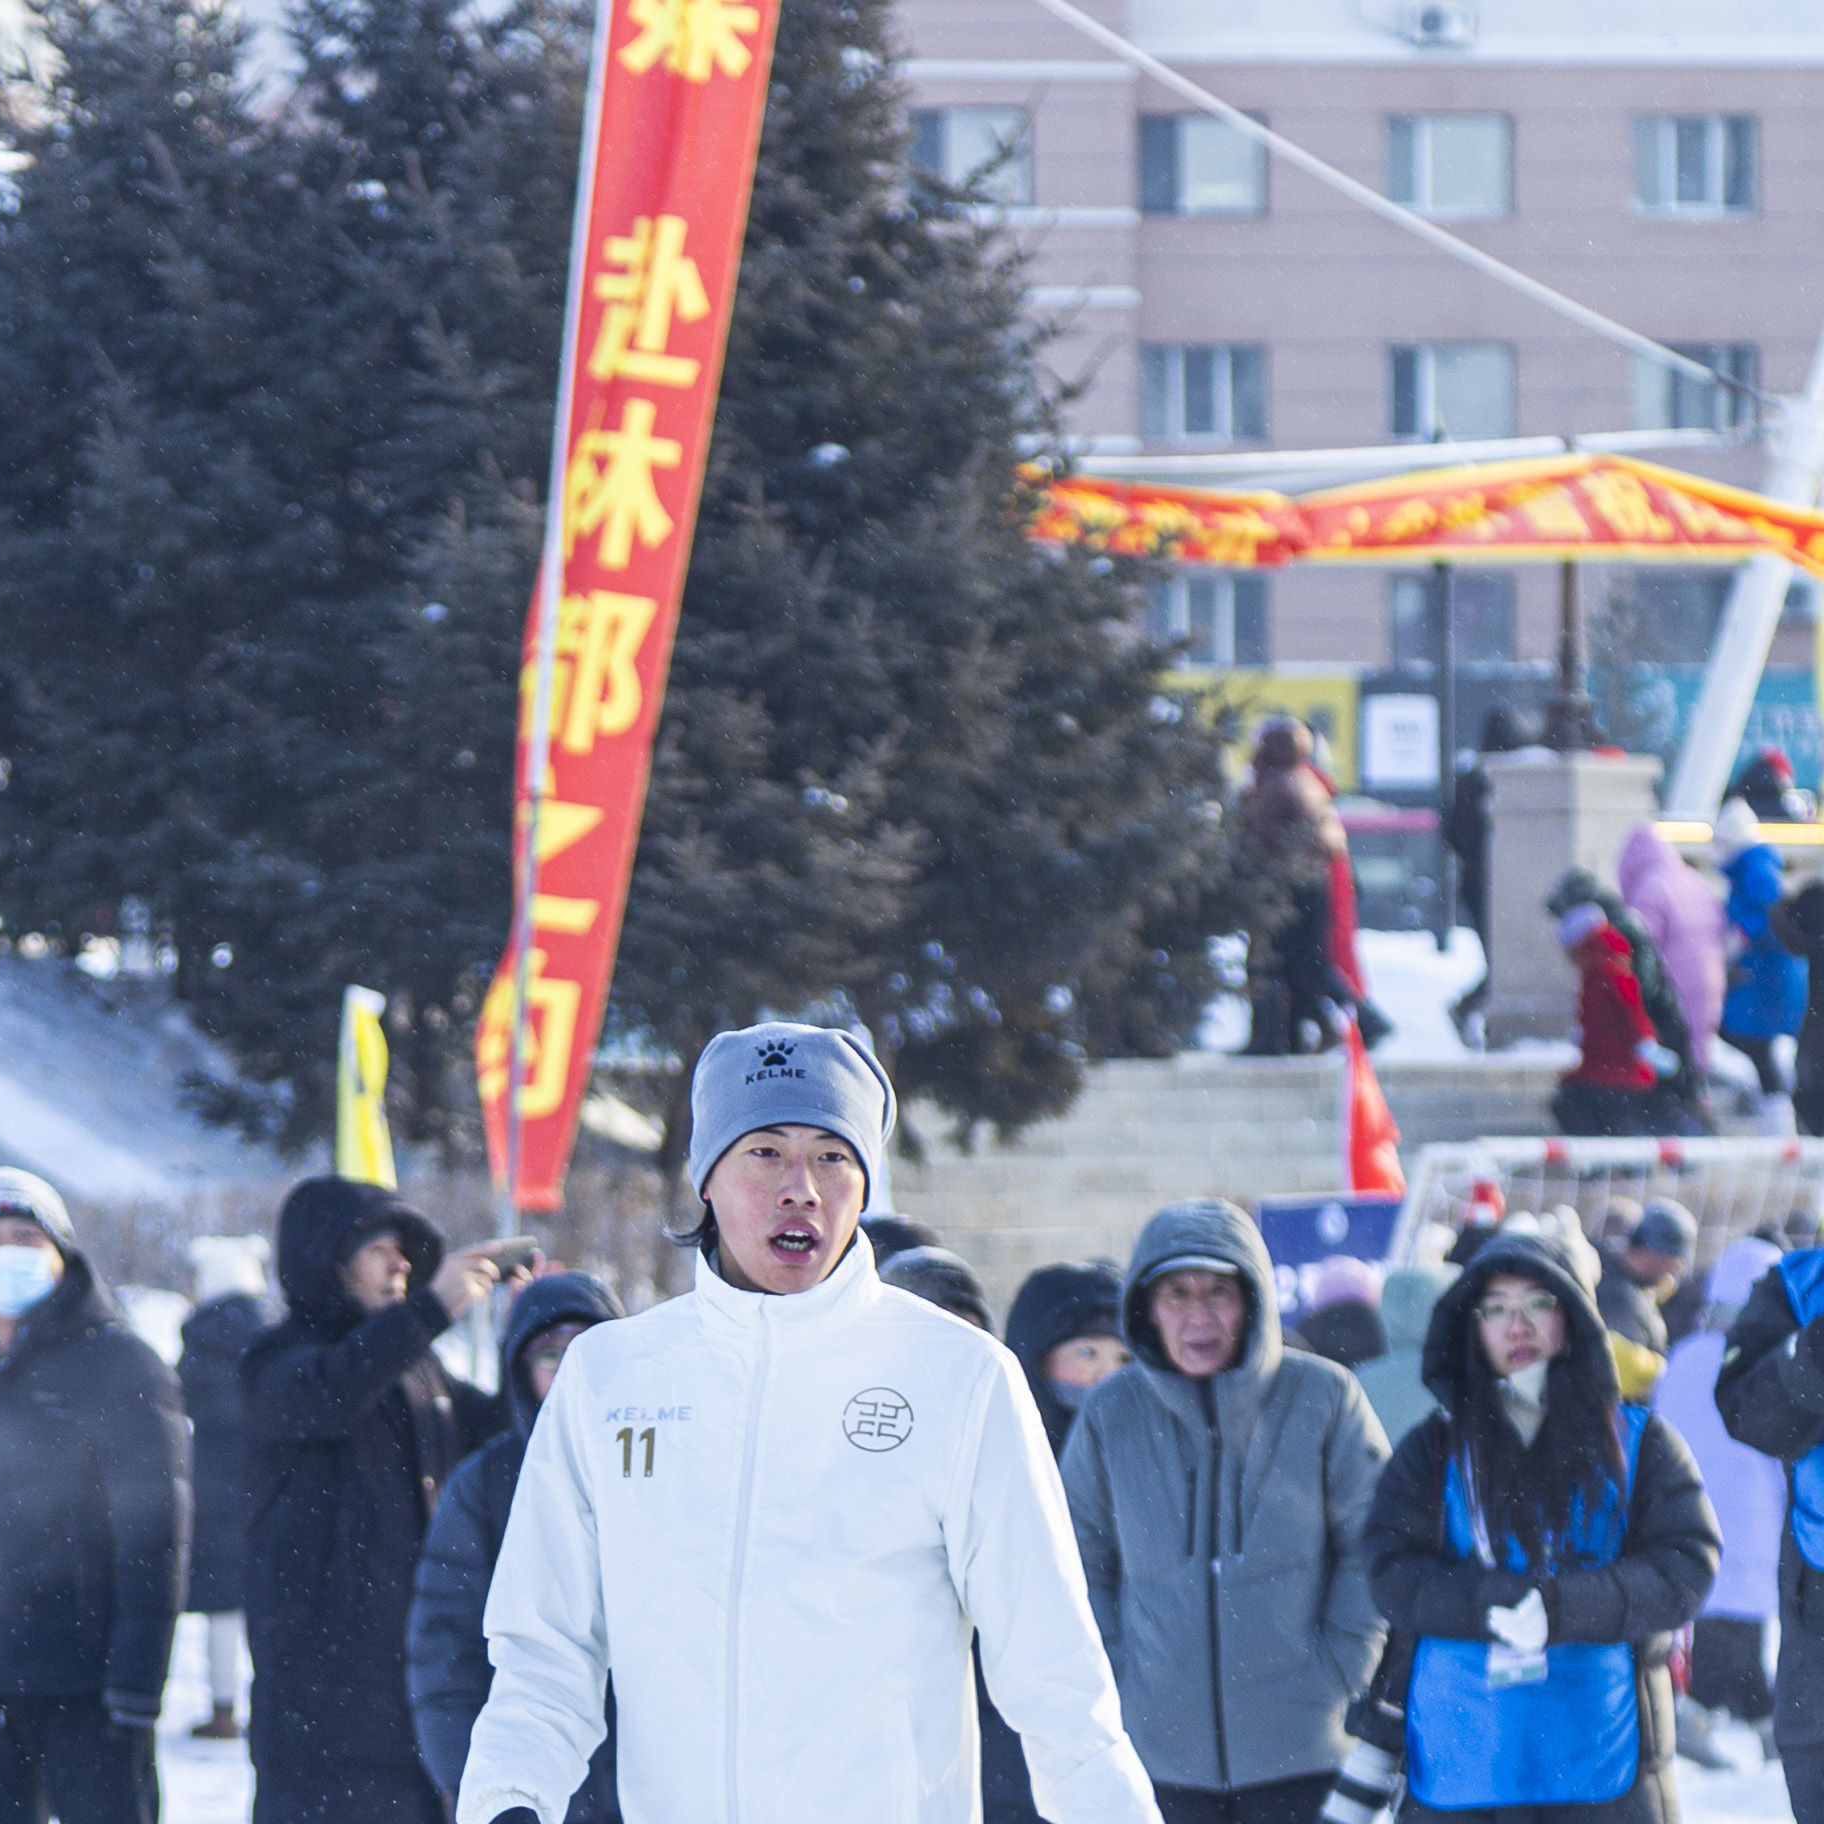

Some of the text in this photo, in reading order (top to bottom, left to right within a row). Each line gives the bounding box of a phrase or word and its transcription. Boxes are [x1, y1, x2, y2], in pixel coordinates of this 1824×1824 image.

[745, 1067, 807, 1086] KELME
[605, 1405, 694, 1423] KELME
[615, 1427, 656, 1478] 11
